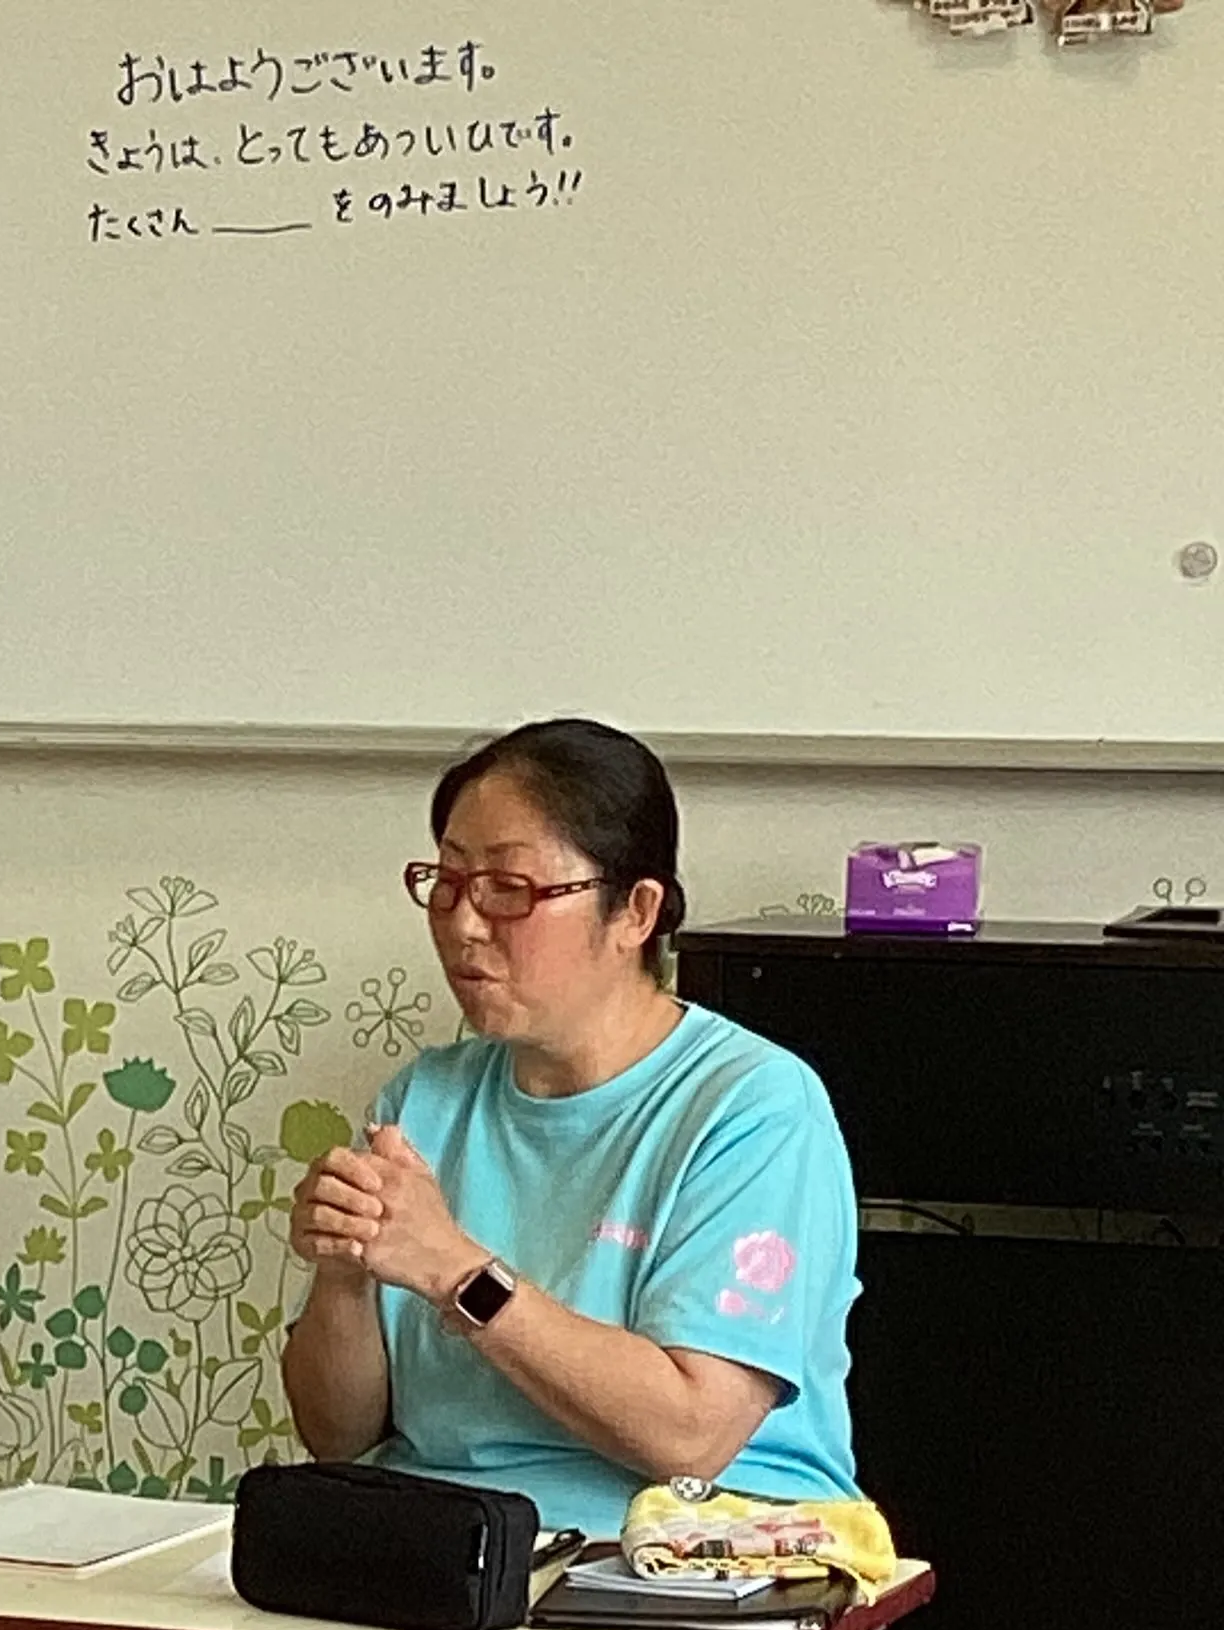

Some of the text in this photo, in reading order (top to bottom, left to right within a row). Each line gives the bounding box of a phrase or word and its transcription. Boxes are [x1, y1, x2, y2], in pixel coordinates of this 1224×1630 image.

[117, 39, 496, 105] おはようございます。
[87, 202, 200, 243] たくさん
